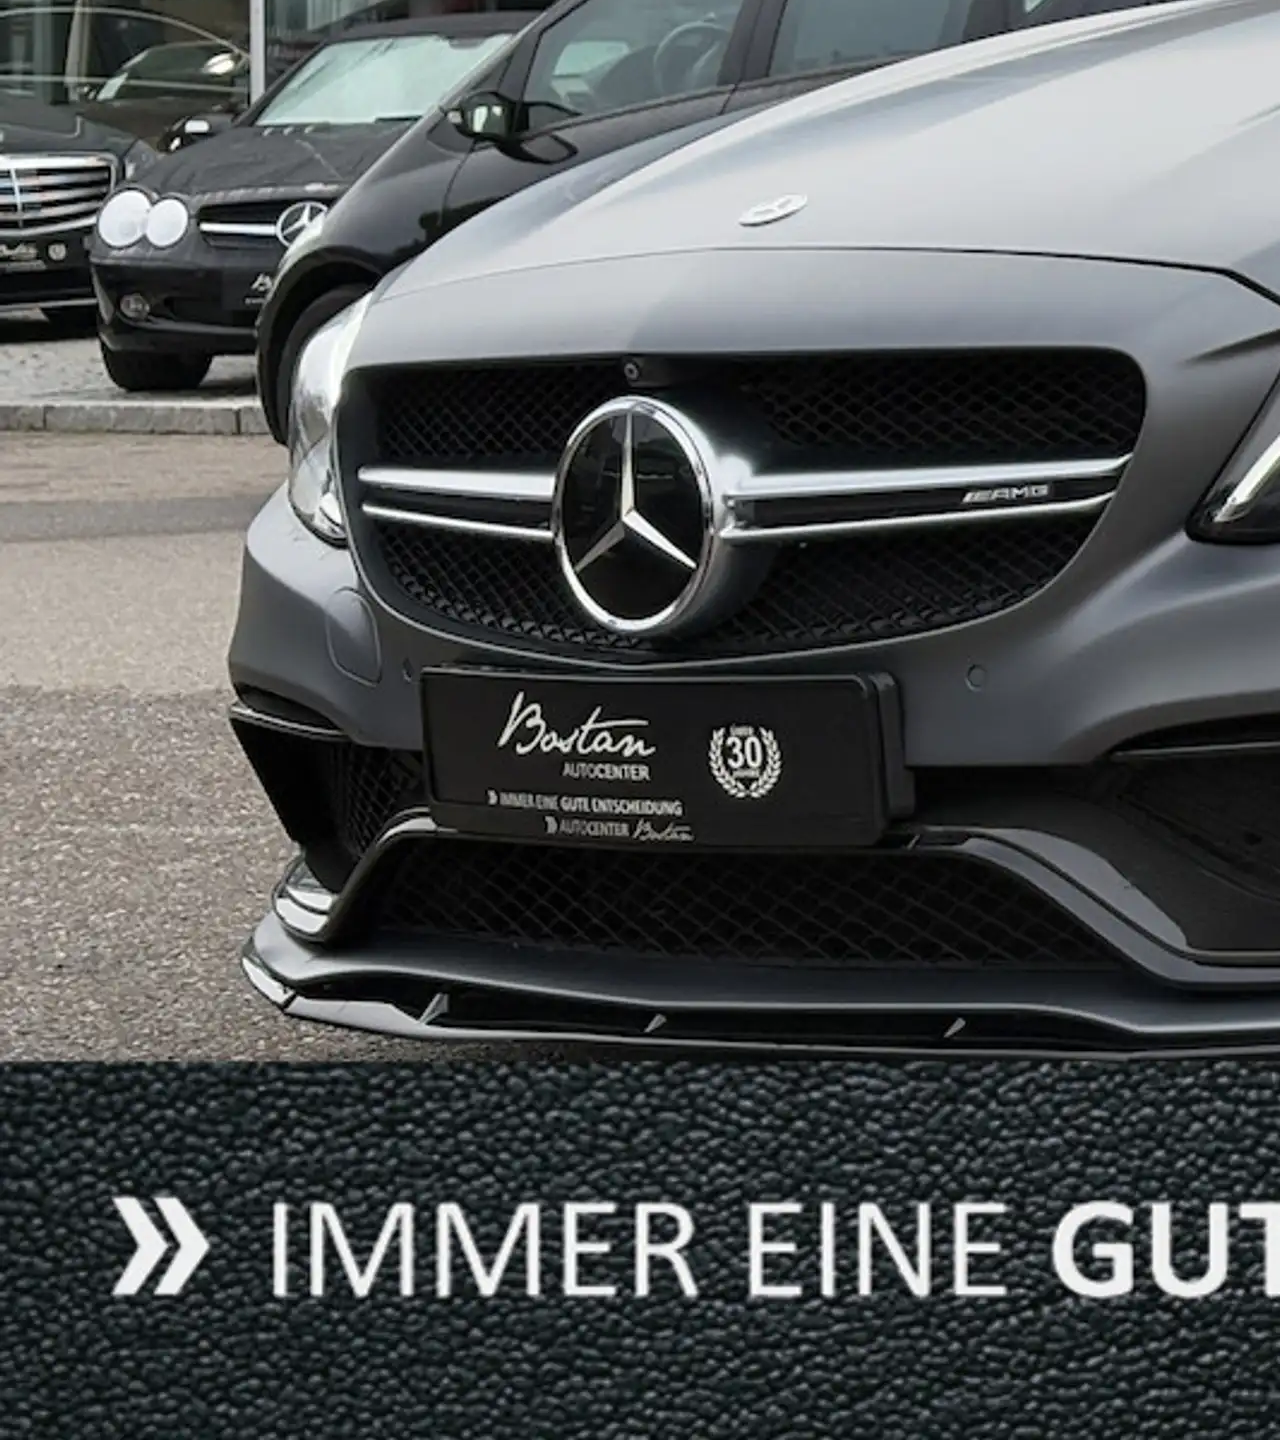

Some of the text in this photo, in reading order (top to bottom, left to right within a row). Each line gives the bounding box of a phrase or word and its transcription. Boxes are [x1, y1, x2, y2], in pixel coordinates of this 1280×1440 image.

[498, 691, 656, 757] Bostan
[726, 736, 762, 769] 30
[562, 762, 650, 781] AUTOCENTER
